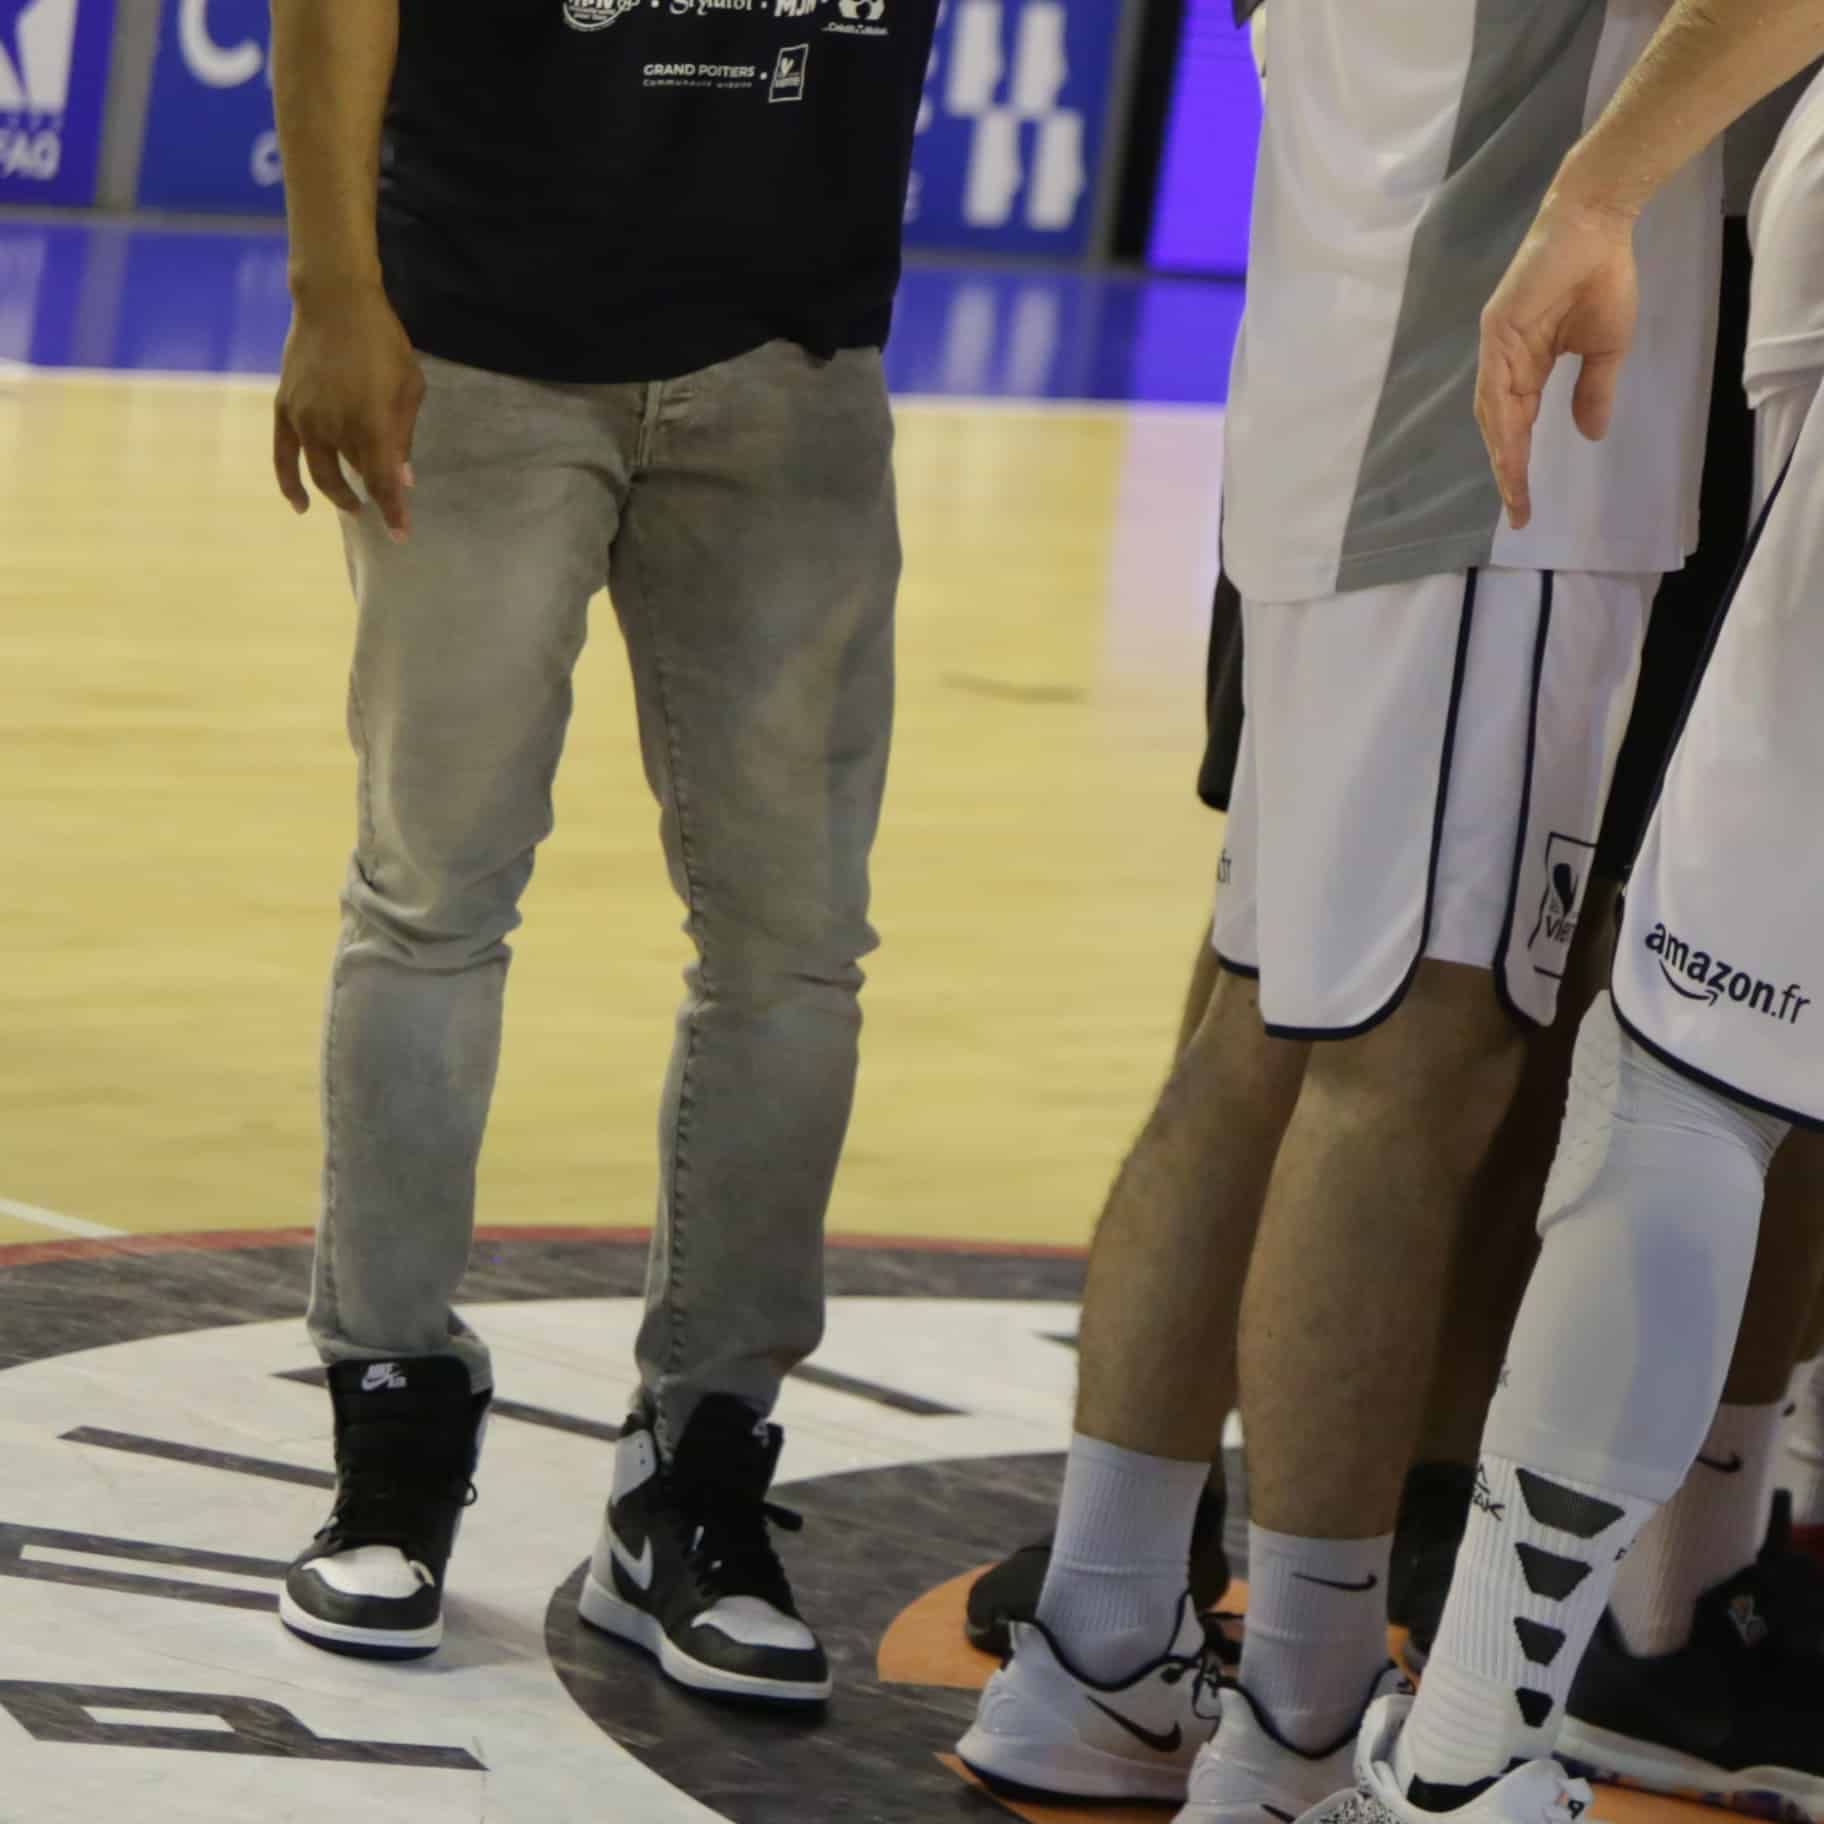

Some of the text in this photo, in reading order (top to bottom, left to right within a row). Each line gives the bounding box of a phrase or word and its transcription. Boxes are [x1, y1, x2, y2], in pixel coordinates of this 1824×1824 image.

[643, 62, 756, 79] GRAND POITIERS
[1645, 922, 1811, 1024] amazon.fr
